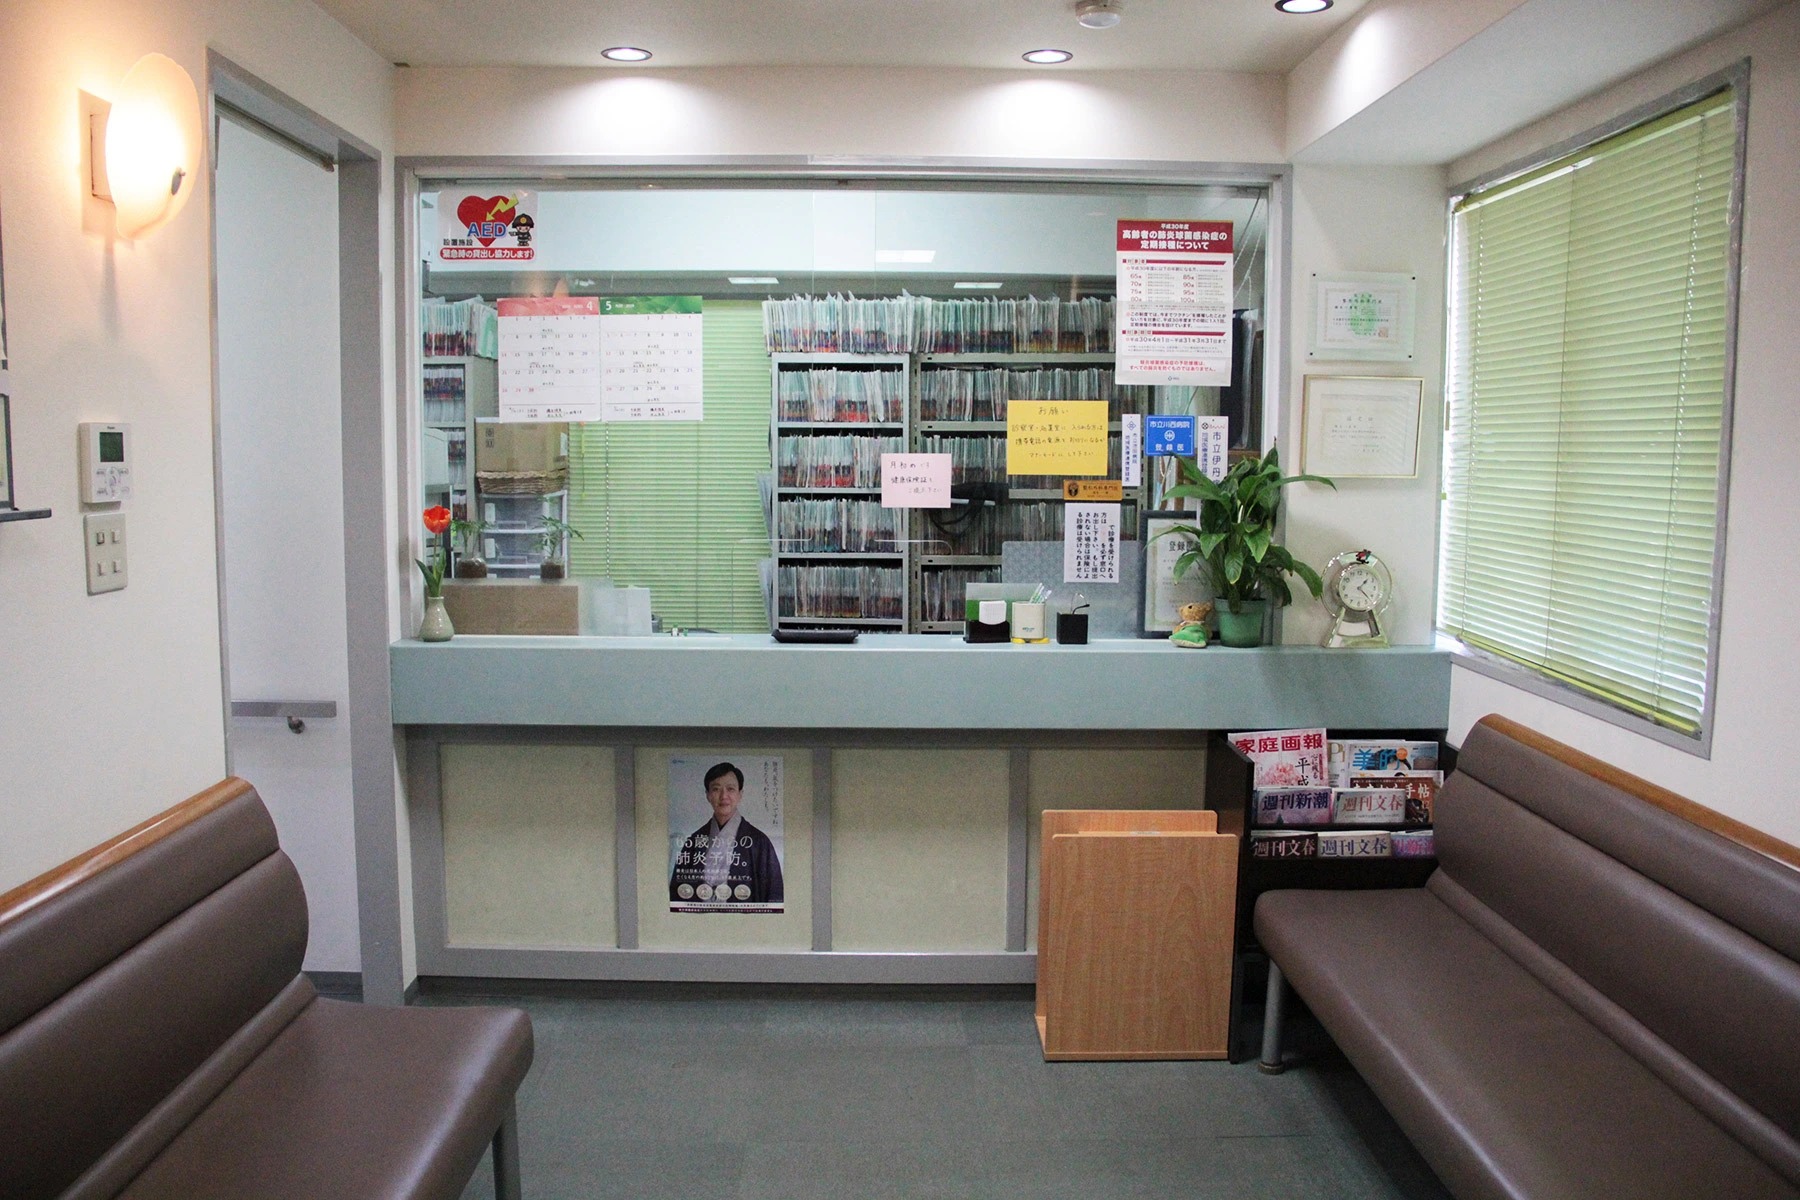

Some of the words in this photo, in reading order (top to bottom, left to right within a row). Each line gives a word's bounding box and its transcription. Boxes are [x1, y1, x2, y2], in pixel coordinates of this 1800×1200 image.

[467, 222, 508, 238] AED
[1122, 229, 1228, 240] 高齢者の肺炎球菌感染症の
[1140, 240, 1210, 250] 定期接種について
[586, 301, 593, 311] 4
[606, 301, 612, 311] 5
[1155, 443, 1184, 451] 登録医
[1101, 512, 1107, 524] 方は
[1236, 733, 1322, 754] 家庭画報
[1262, 792, 1329, 811] 週刊新潮
[1343, 794, 1403, 812] 週刊文春
[1253, 839, 1316, 857] 週刊文春
[1321, 838, 1387, 856] 週刊文春
[676, 851, 747, 867] 肺炎予防。
